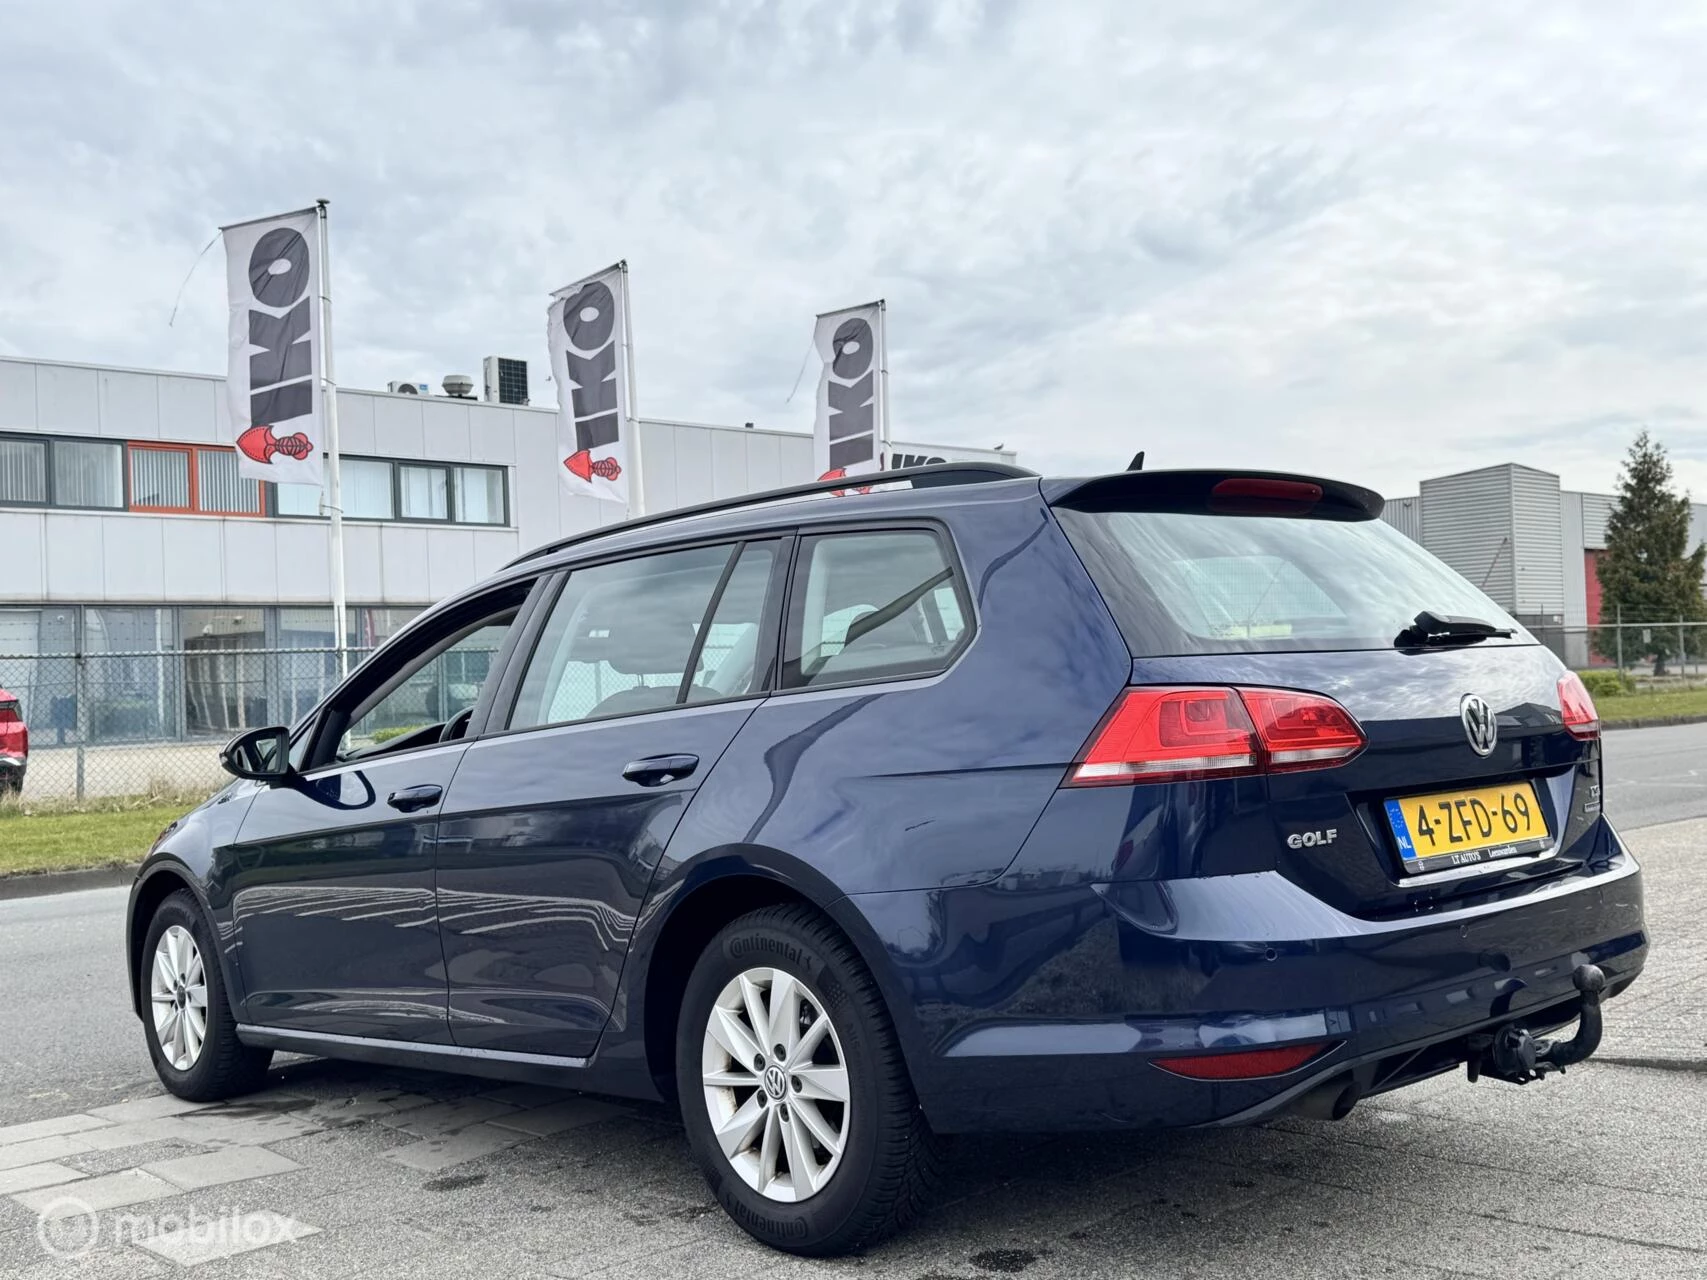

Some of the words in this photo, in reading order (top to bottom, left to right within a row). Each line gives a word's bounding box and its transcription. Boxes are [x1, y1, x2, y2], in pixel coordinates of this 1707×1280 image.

[249, 227, 313, 428] IKO
[563, 280, 619, 451] IKO
[827, 317, 874, 471] IKO
[1287, 828, 1337, 849] GOLF
[1397, 836, 1412, 849] NL
[1417, 793, 1531, 846] 4-ZFD-69
[730, 933, 803, 965] Continental
